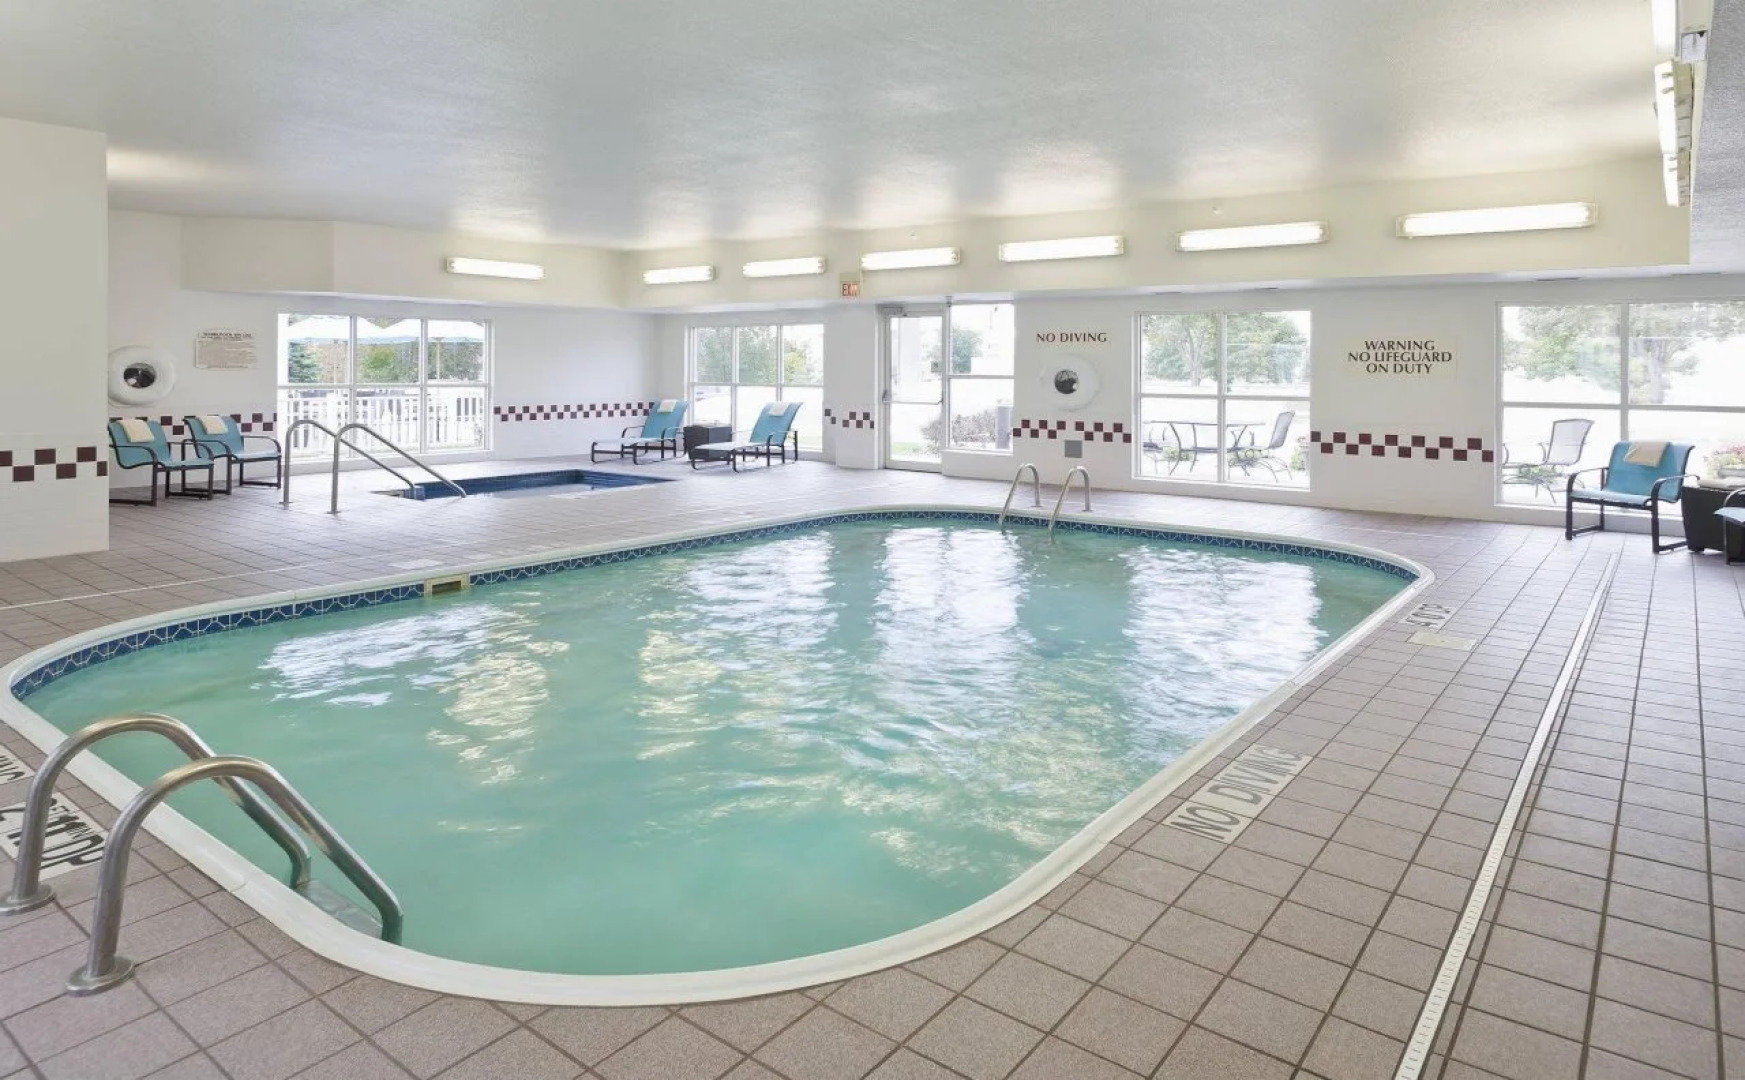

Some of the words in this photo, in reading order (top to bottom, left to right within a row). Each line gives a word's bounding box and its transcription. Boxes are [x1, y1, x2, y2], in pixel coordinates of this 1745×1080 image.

[1037, 332, 1056, 343] NO
[1060, 332, 1107, 343] DIVING
[1365, 340, 1435, 351] WARNING
[1348, 352, 1371, 362] NO
[1375, 352, 1453, 362] LIFEGUARD
[1366, 363, 1389, 374] ON
[1393, 363, 1433, 374] DUTY
[1170, 806, 1240, 840] NO
